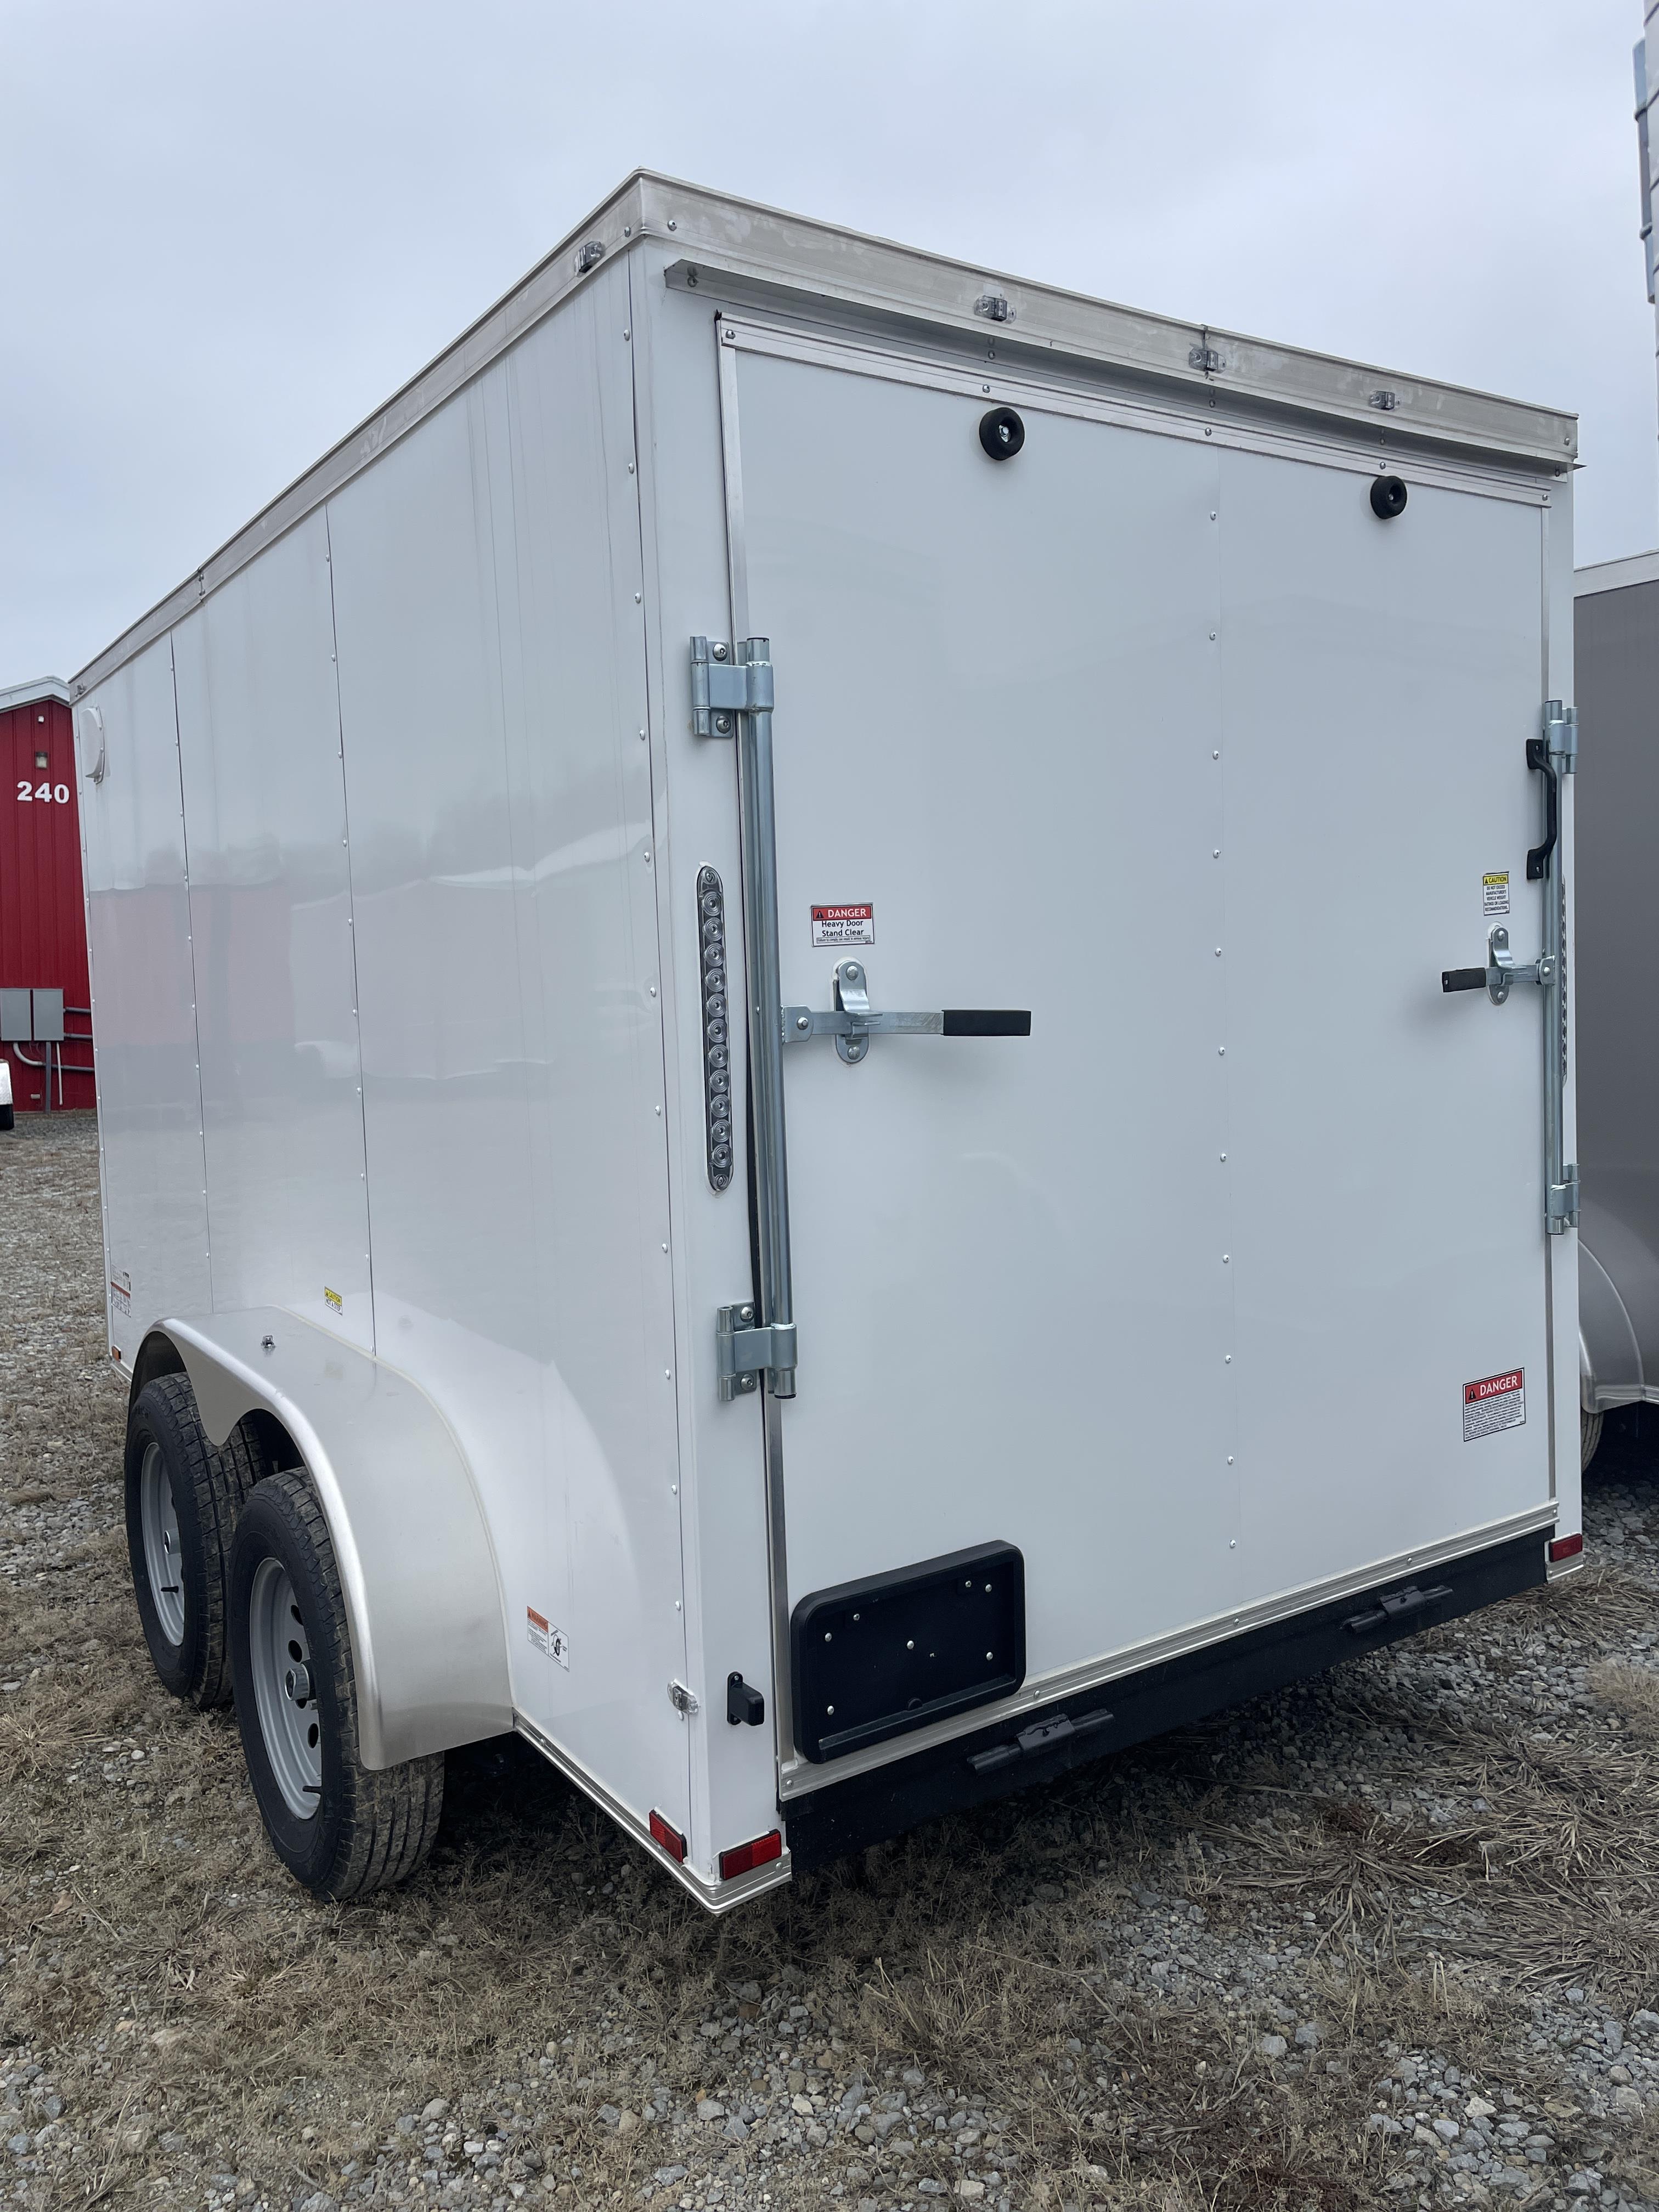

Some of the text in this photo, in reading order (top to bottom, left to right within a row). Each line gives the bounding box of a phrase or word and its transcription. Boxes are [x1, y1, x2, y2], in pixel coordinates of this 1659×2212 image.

[17, 781, 70, 804] 240
[828, 909, 866, 918] DANGER
[1480, 1375, 1518, 1396] DANGER
